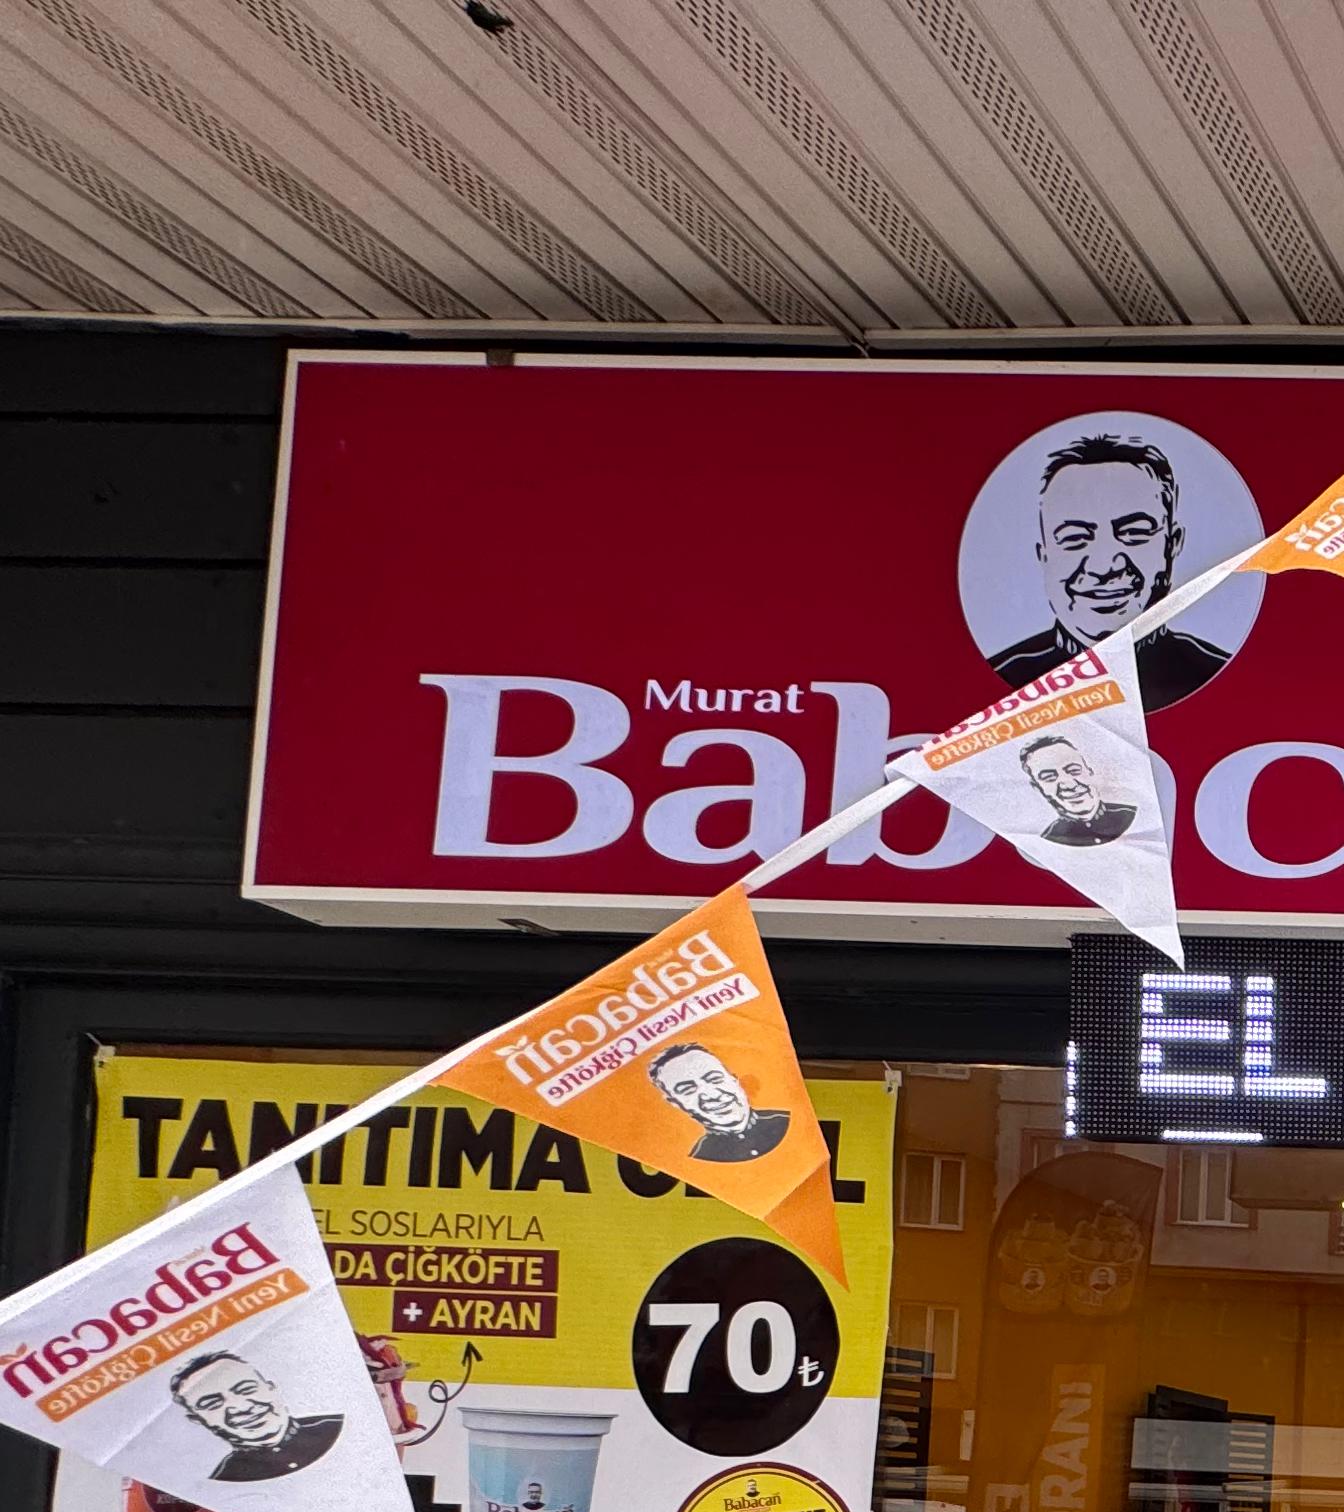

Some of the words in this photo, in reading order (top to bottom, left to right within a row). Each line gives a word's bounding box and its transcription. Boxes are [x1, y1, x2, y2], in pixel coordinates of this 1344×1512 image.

[644, 679, 805, 714] Murat
[1139, 972, 1331, 1099] EL
[349, 1210, 545, 1241] SOSLARIYLA
[385, 1243, 544, 1288] ÇİĞKÖFTE
[430, 1297, 542, 1329] AYRAN
